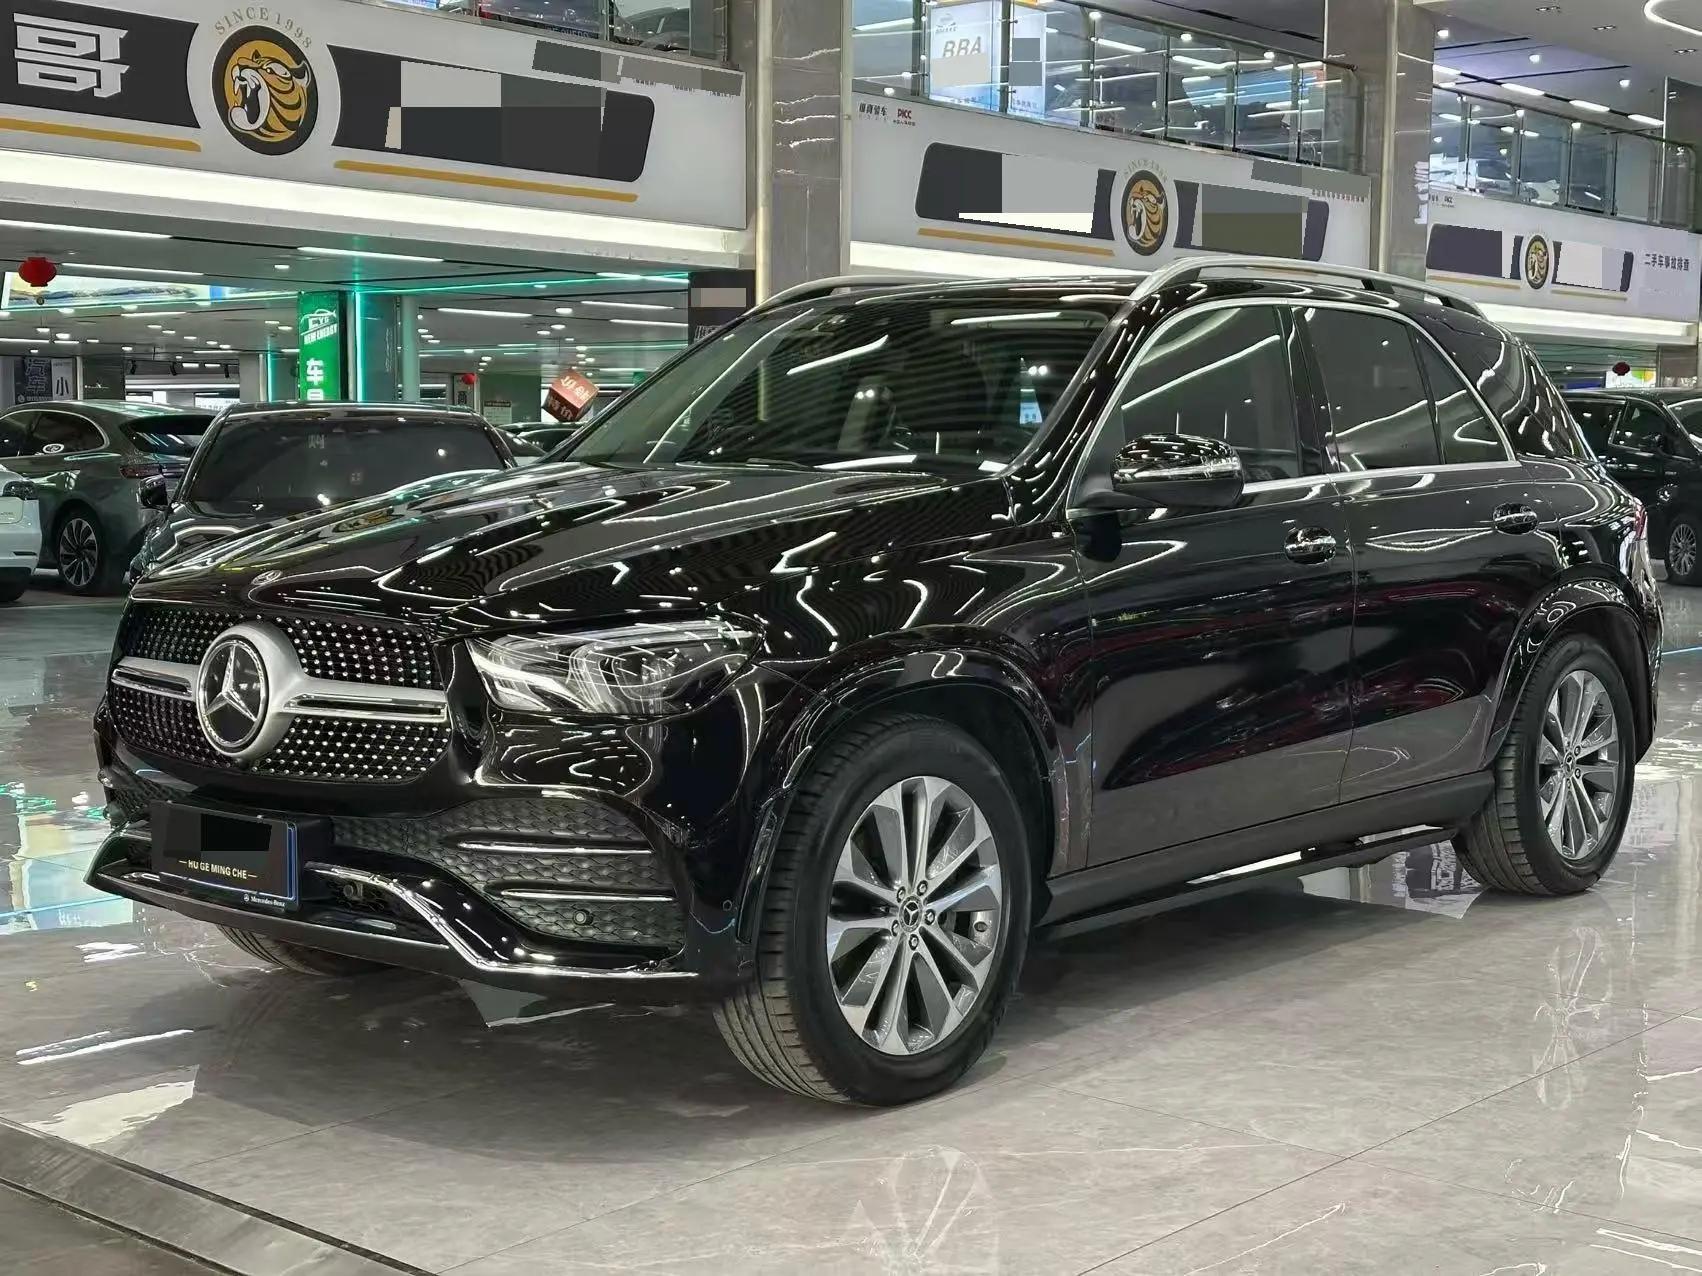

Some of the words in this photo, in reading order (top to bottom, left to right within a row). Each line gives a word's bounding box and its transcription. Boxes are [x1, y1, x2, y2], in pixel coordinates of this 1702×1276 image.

[214, 6, 269, 35] SINCE
[276, 12, 312, 49] 1998
[13, 12, 130, 98] 哥
[897, 108, 912, 119] PICC
[188, 859, 199, 870] HU
[199, 862, 210, 872] GE
[210, 864, 231, 876] MING
[232, 867, 248, 880] CHE
[250, 895, 286, 908] Mercedes-Benz
